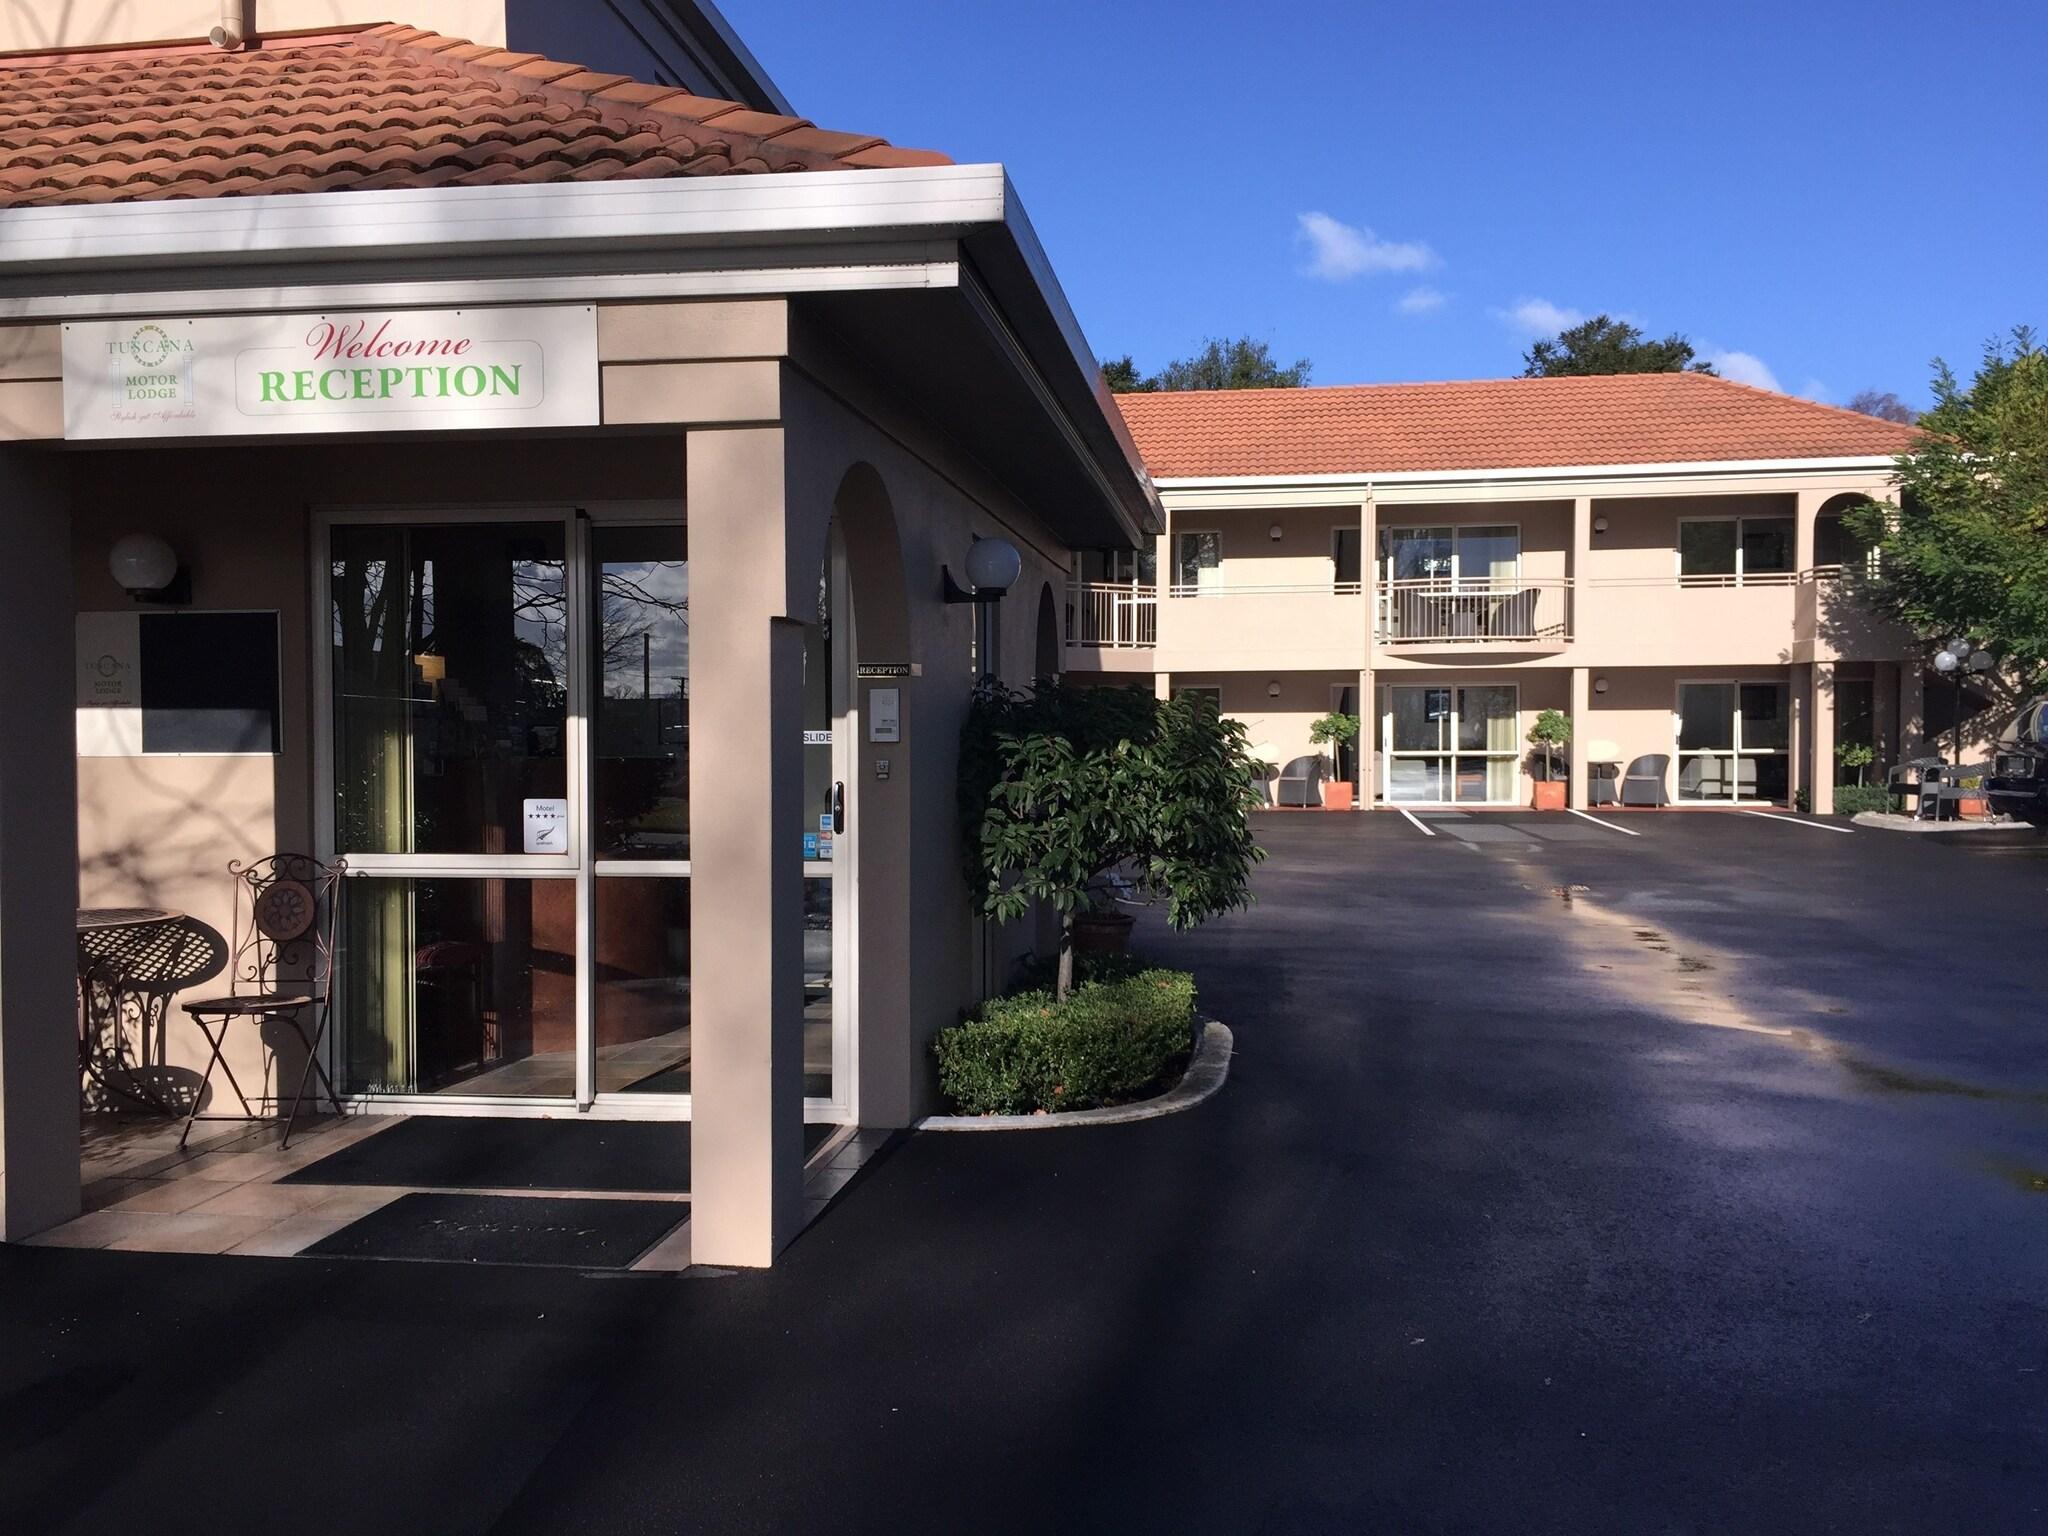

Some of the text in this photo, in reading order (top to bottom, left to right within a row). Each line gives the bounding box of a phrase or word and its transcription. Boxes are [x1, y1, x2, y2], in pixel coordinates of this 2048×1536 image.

[305, 318, 473, 361] Welcome
[106, 339, 195, 354] TUSCANA
[126, 375, 178, 387] MOTOR
[258, 364, 523, 402] RECEPTION
[128, 388, 177, 400] LODGE
[859, 665, 909, 674] RECEPTION
[803, 733, 832, 743] SLIDE
